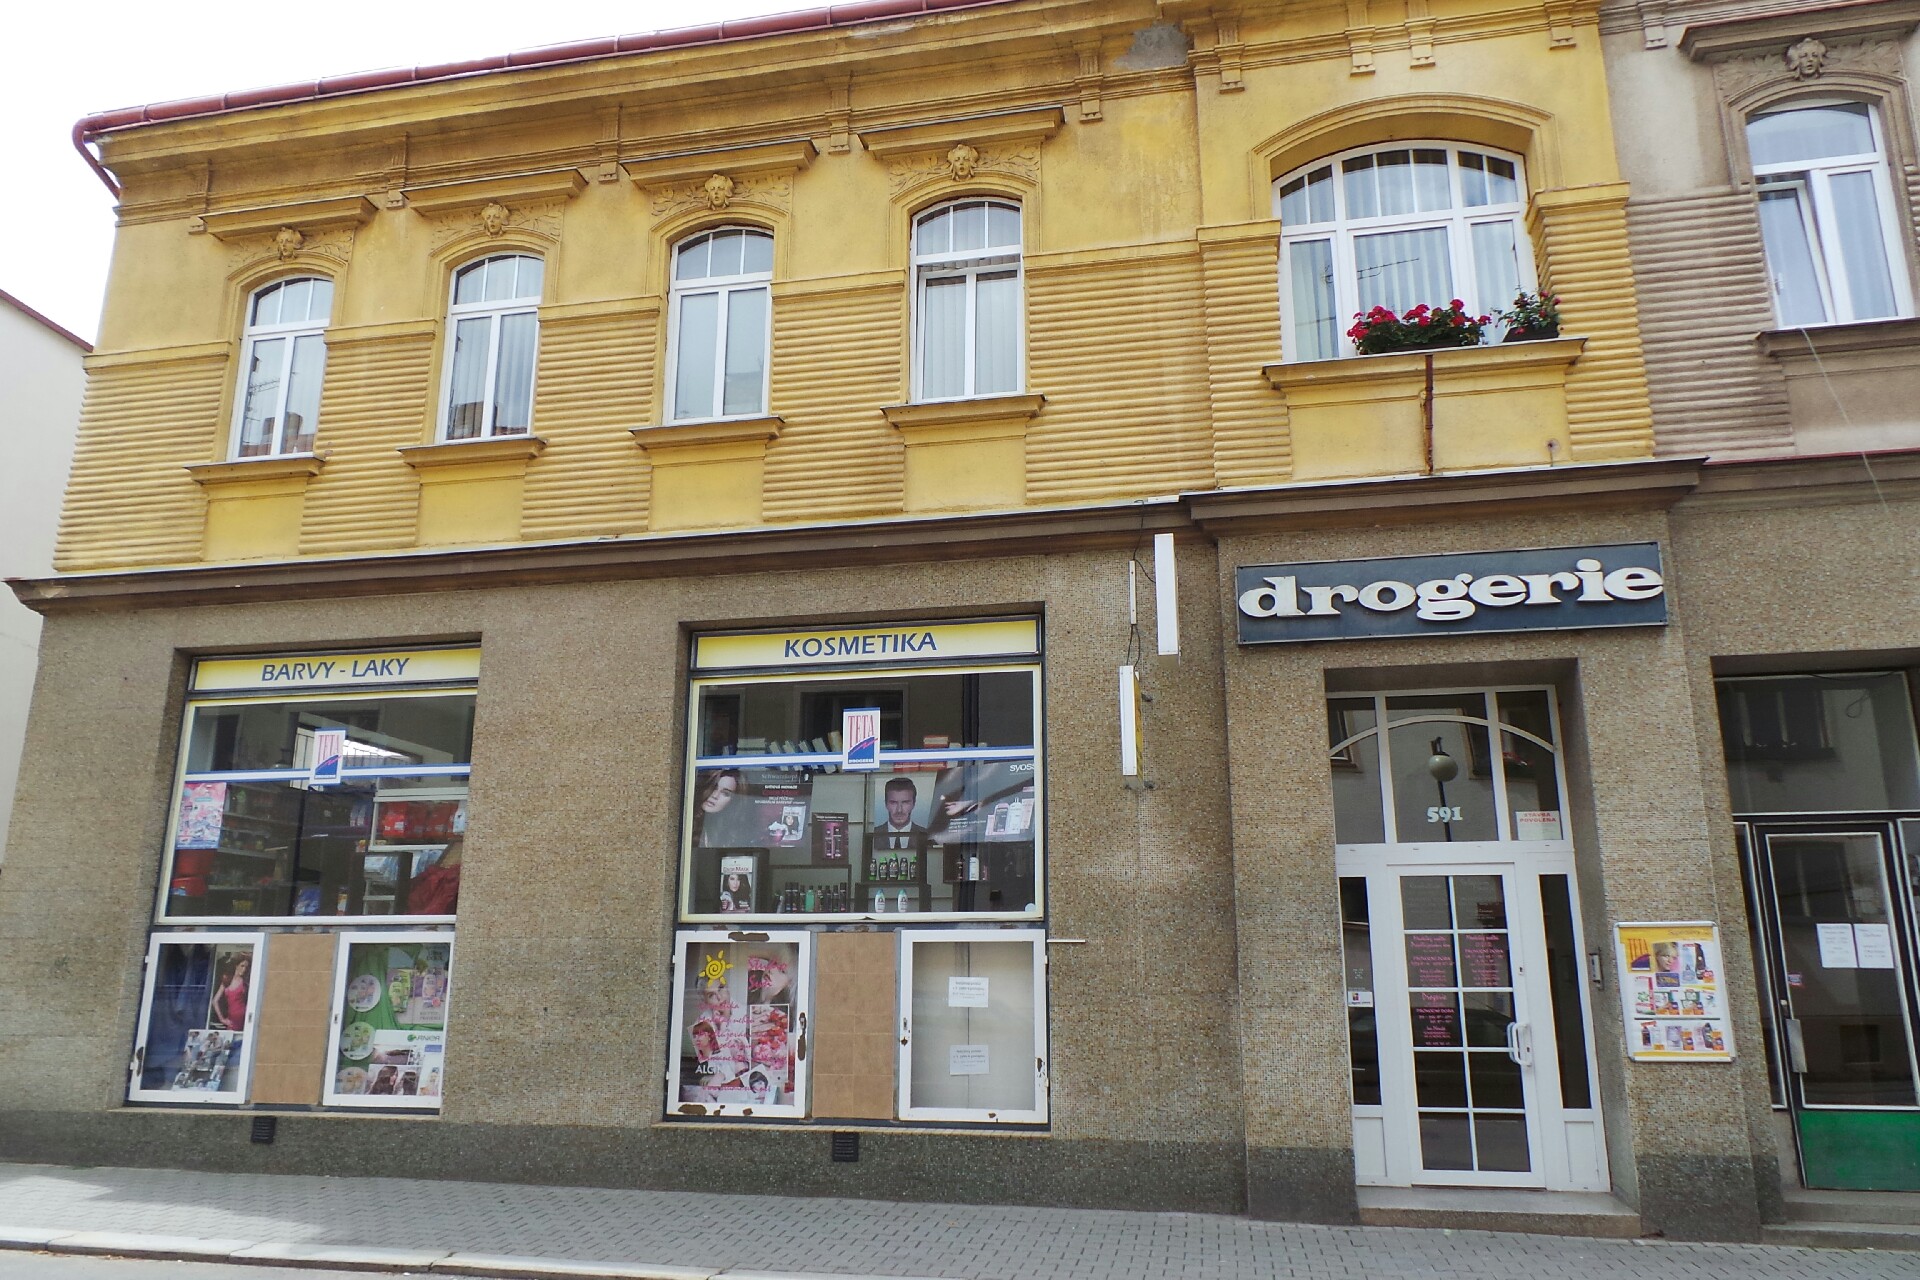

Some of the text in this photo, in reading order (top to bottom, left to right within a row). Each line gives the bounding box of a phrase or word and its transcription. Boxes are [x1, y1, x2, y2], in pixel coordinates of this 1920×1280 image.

[1238, 557, 1664, 623] drogerie
[783, 632, 937, 658] KOSMETIKA
[262, 661, 335, 682] BARVY
[351, 657, 410, 678] LAKY
[1427, 806, 1464, 823] 591
